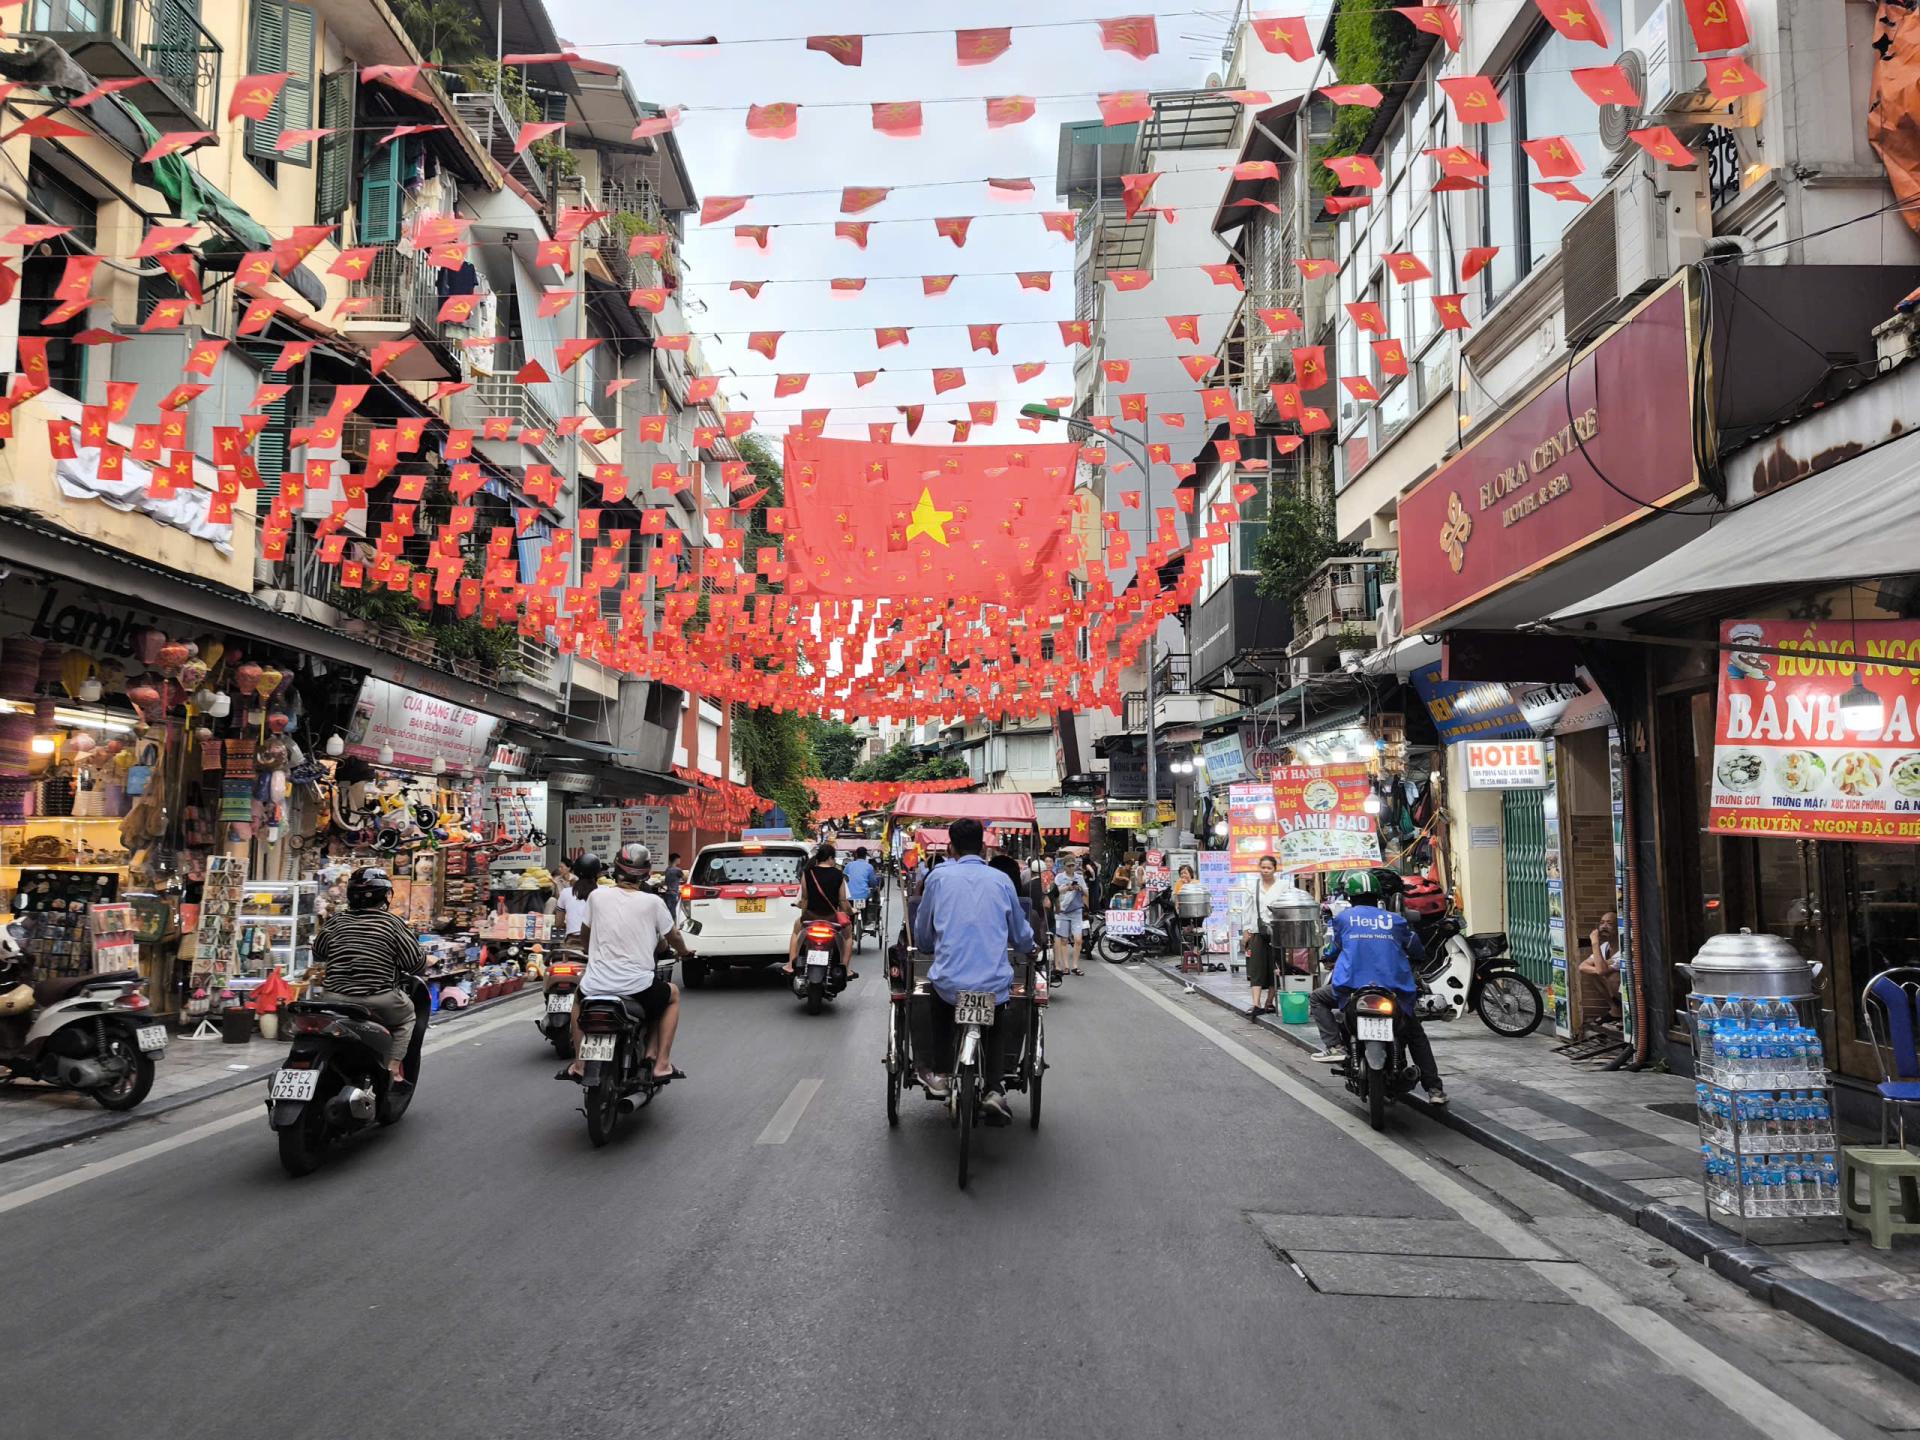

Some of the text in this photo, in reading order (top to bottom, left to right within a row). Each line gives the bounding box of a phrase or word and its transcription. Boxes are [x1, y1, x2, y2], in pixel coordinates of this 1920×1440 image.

[1479, 407, 1599, 511] FLORA CENTRE
[1726, 680, 1844, 741] BÁNH
[1470, 745, 1542, 767] HOTEL
[1291, 767, 1322, 781] HẠNH
[1894, 798, 1910, 811] GÀ
[1336, 815, 1369, 832] BAO
[1812, 819, 1859, 834] NGON
[1860, 817, 1896, 838] ĐẶC
[1106, 911, 1144, 922] MONEY
[964, 993, 988, 1009] 29XL
[959, 1008, 991, 1023] 0205
[272, 1085, 312, 1099] 025.81
